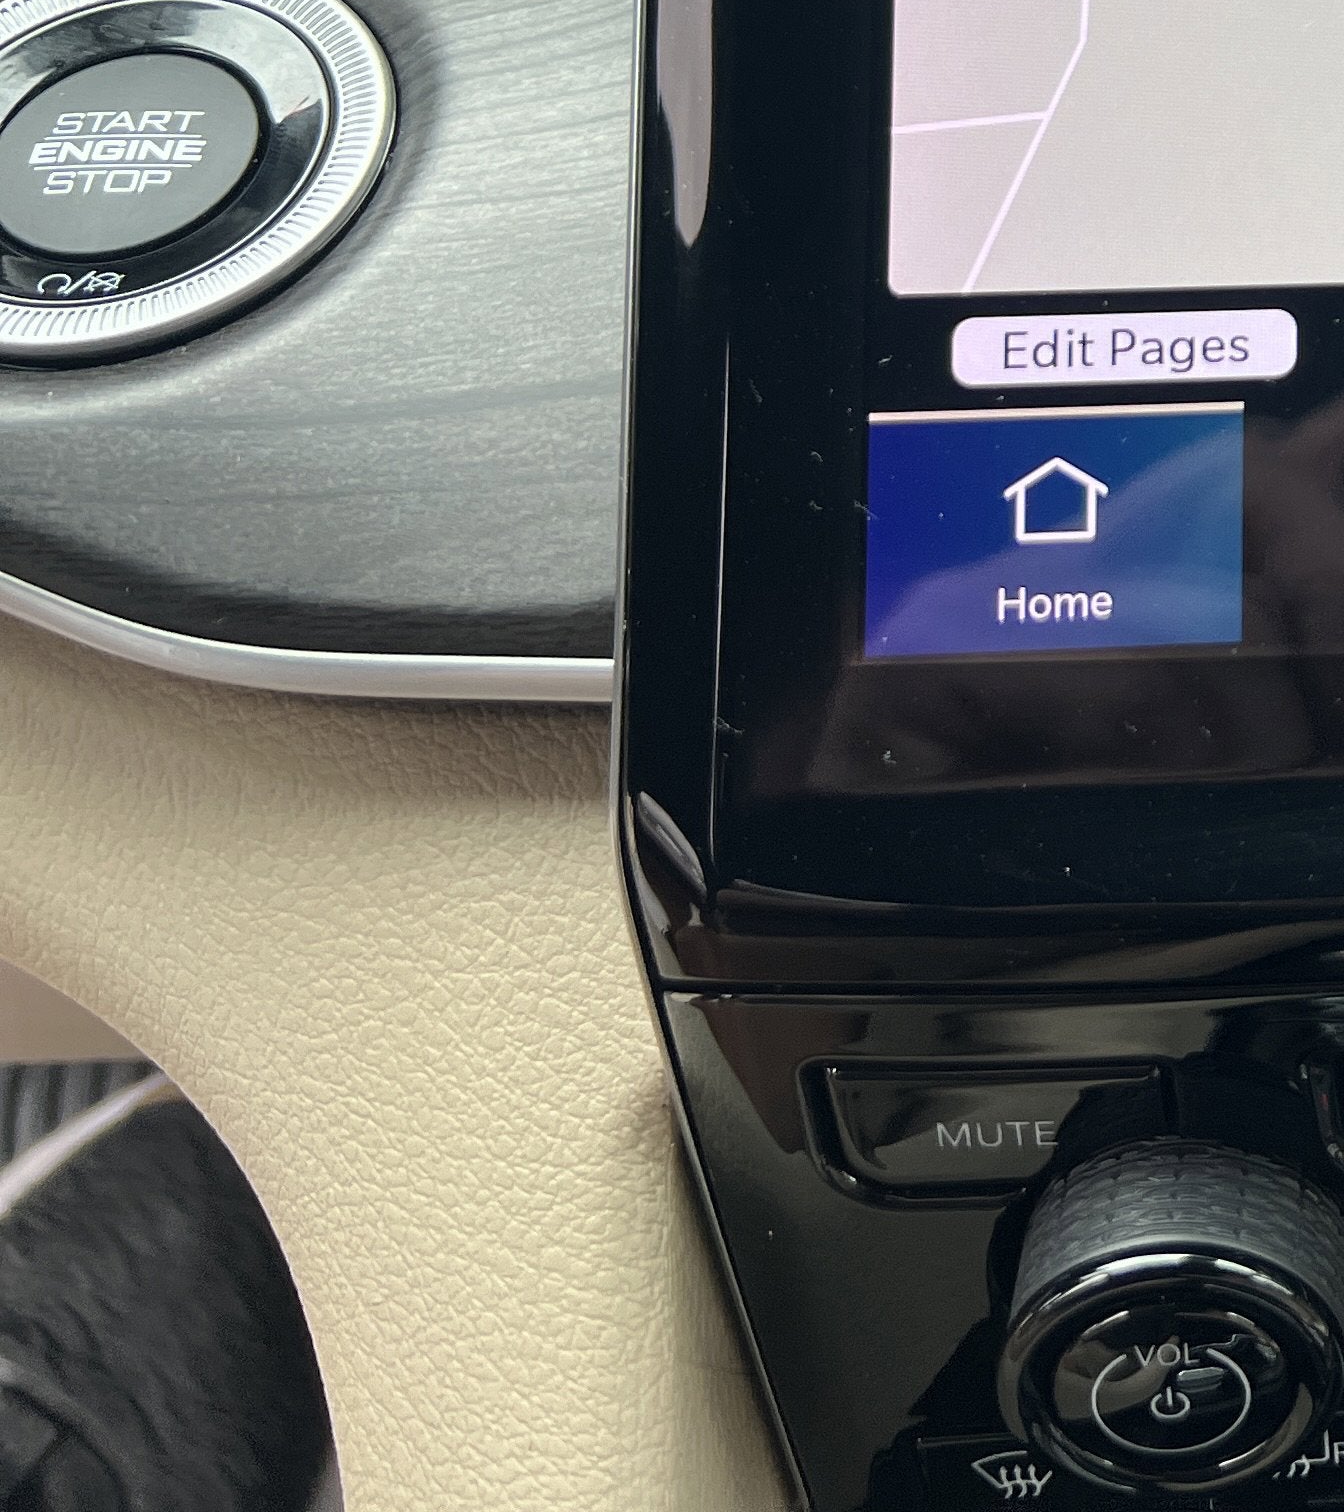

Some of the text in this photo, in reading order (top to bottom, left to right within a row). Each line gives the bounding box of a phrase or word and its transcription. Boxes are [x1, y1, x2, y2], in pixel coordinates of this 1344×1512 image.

[52, 110, 206, 136] START
[28, 139, 207, 165] ENGINE
[42, 170, 172, 195] STOP
[1000, 327, 1251, 372] Edit Pages
[997, 583, 1114, 624] Home
[936, 1120, 1060, 1150] MUTE
[1134, 1343, 1200, 1370] VOL
